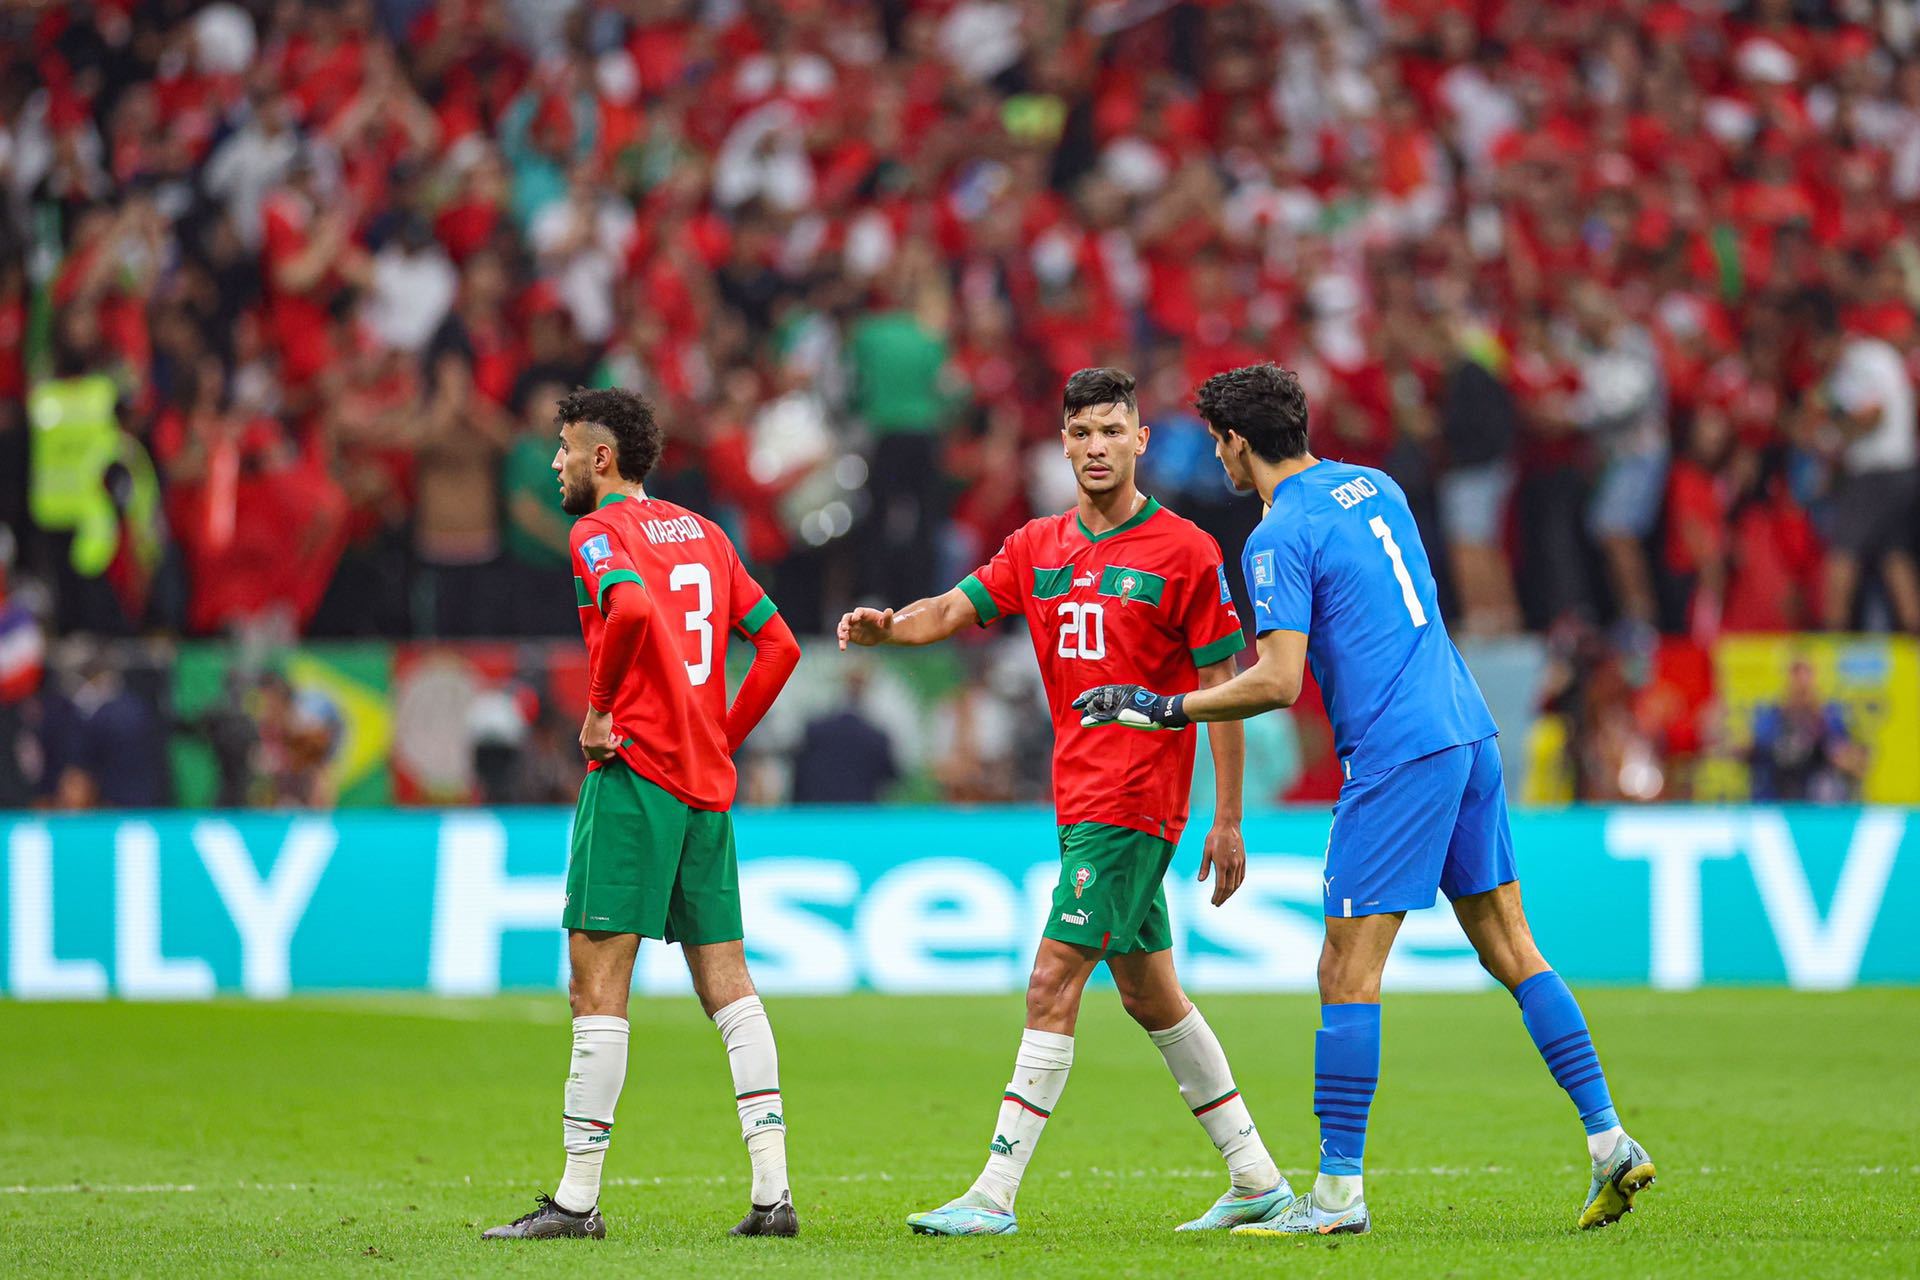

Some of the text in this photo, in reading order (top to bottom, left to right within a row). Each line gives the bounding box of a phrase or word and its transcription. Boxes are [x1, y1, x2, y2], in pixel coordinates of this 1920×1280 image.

[1330, 476, 1378, 510] BONO
[1368, 515, 1428, 628] 1
[669, 562, 713, 687] 3
[1057, 602, 1106, 661] 20
[7, 806, 1908, 1000] LLY Hses TV
[1061, 912, 1085, 926] PUMA
